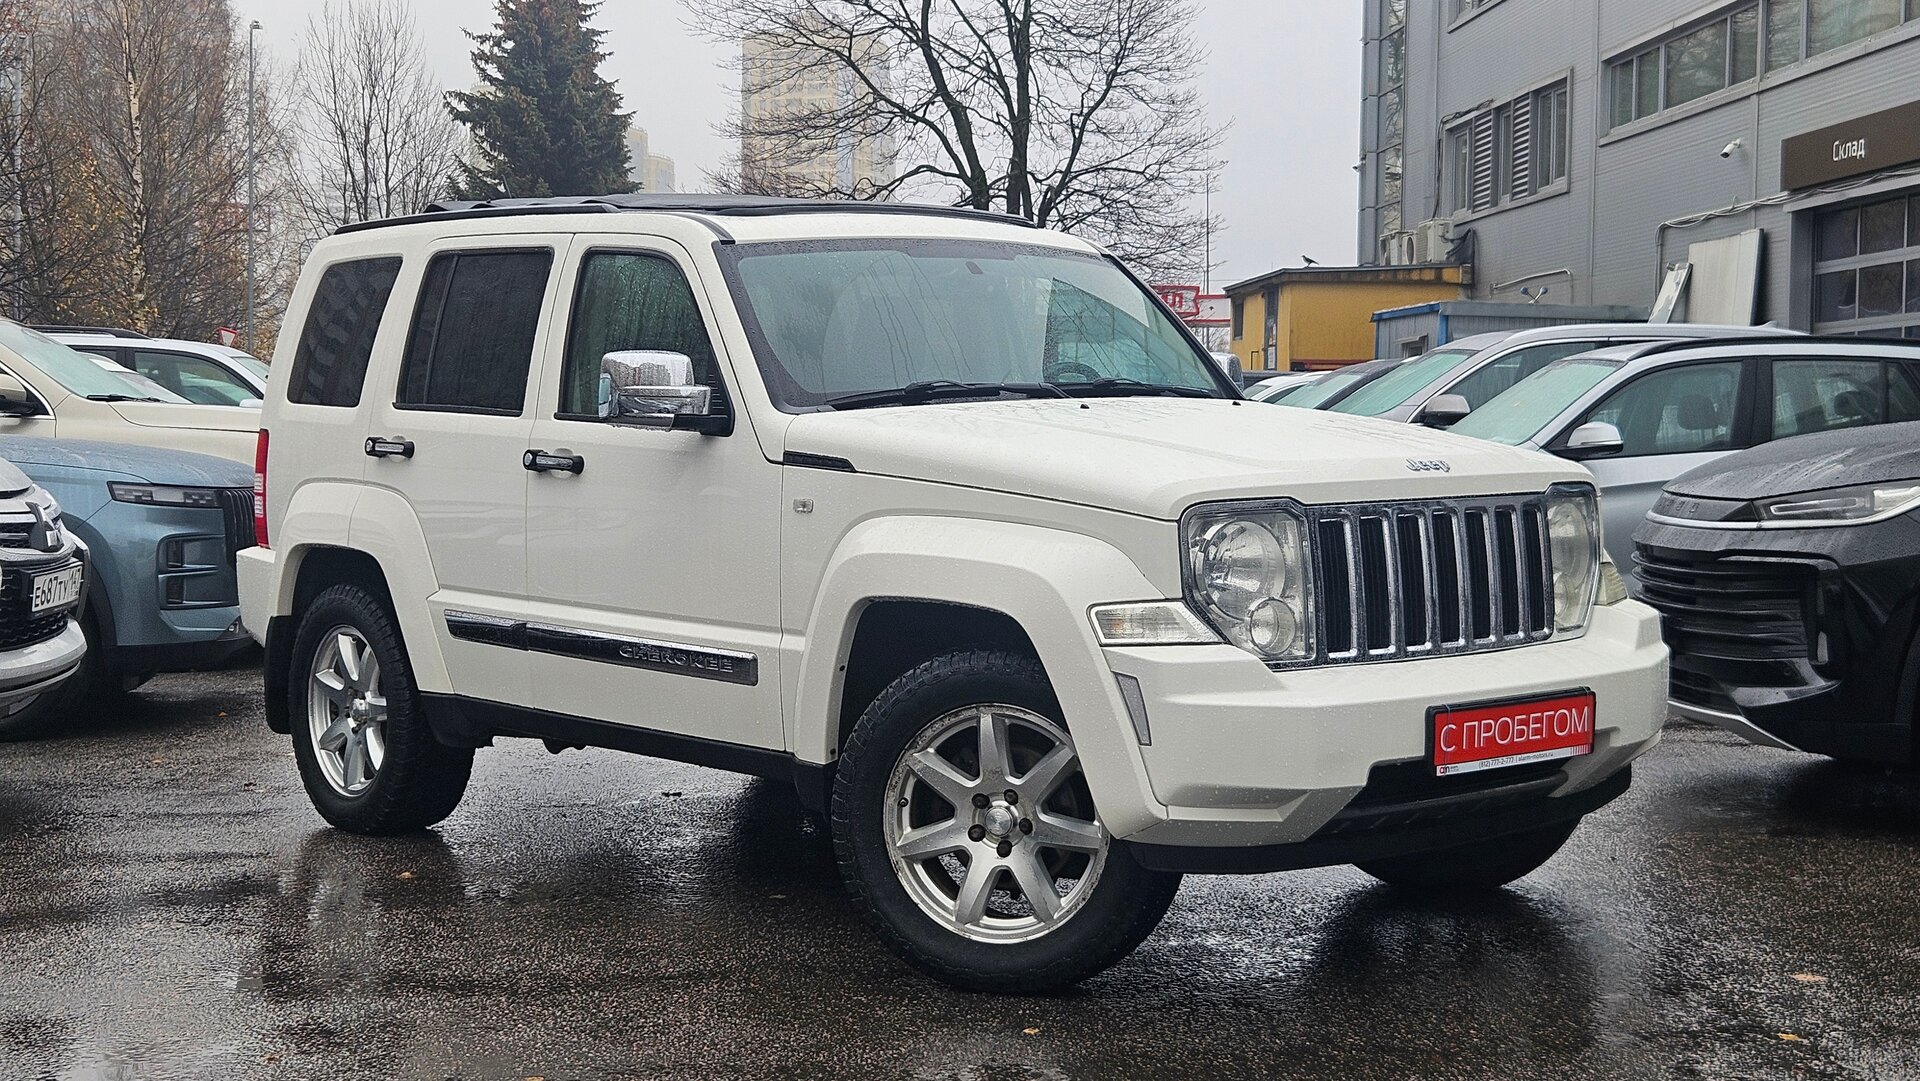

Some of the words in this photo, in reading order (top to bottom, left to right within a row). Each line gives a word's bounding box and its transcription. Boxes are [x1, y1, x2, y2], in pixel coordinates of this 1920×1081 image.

[1832, 138, 1865, 161] Склад
[1405, 458, 1451, 473] Jeep
[619, 644, 734, 673] CHEROKEE
[1440, 724, 1457, 752] С
[1462, 706, 1589, 750] ПРОБЕГОМ
